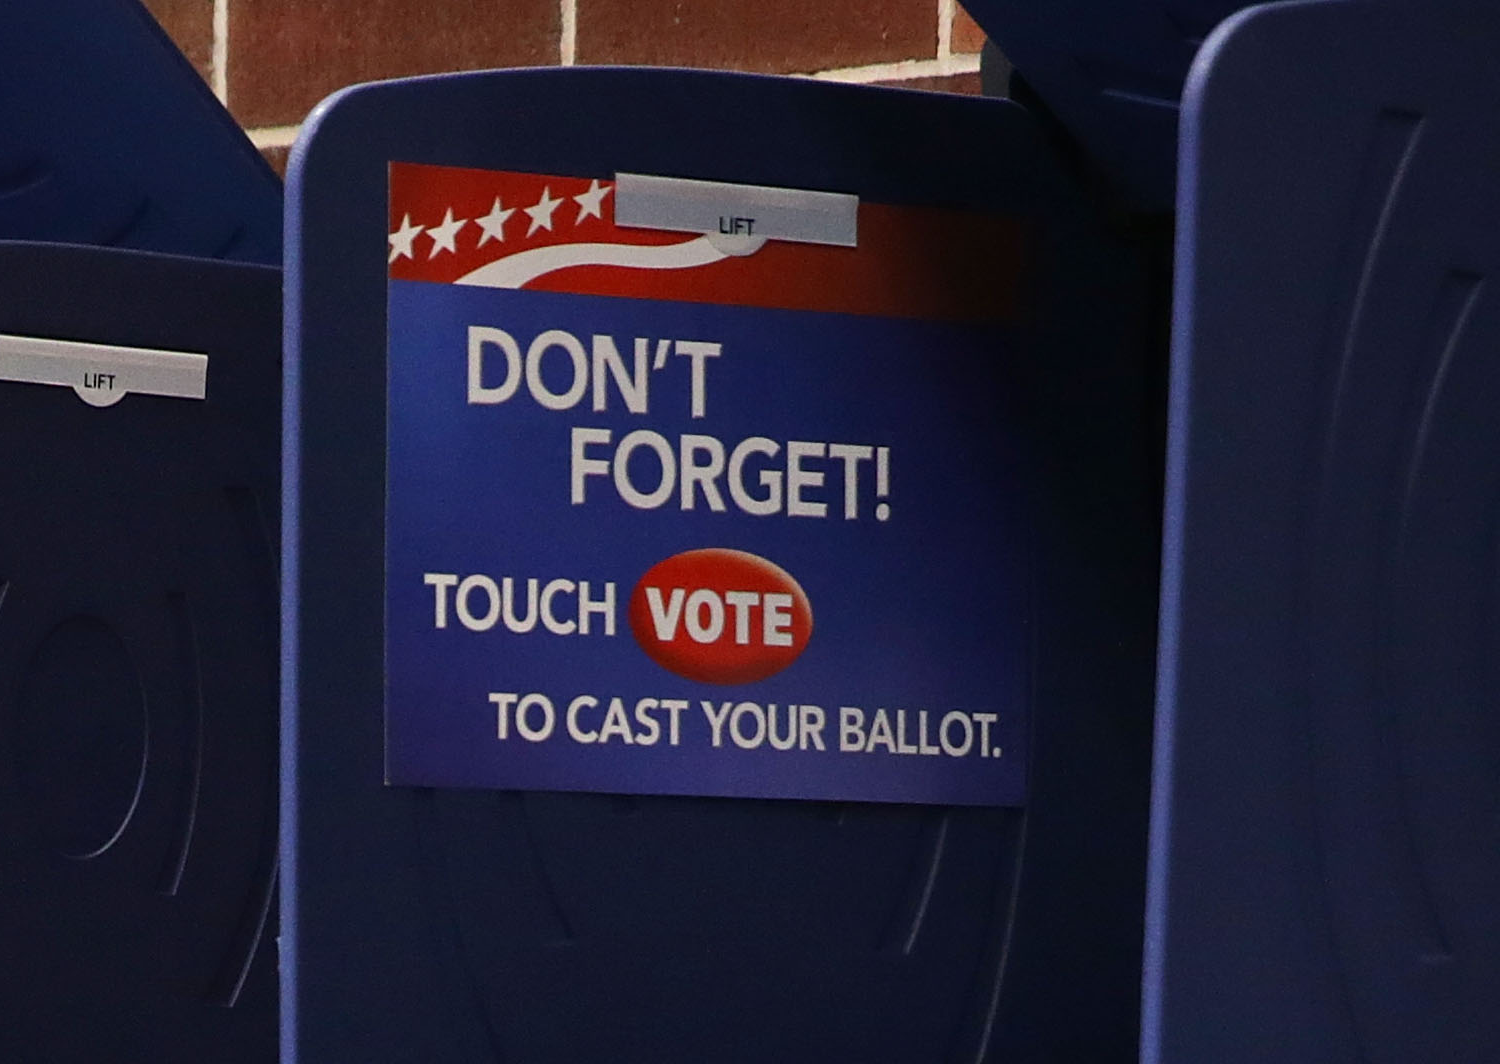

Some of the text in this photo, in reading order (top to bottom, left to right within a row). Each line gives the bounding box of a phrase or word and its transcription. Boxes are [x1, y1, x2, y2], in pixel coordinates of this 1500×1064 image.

[718, 216, 756, 236] LIFT
[83, 372, 116, 391] LIFT
[466, 324, 723, 419] DON'T
[570, 427, 892, 522] FORGET!
[423, 572, 794, 647] TOUCH VOTE
[488, 691, 1002, 758] TO CAST YOUR BALLOT.
